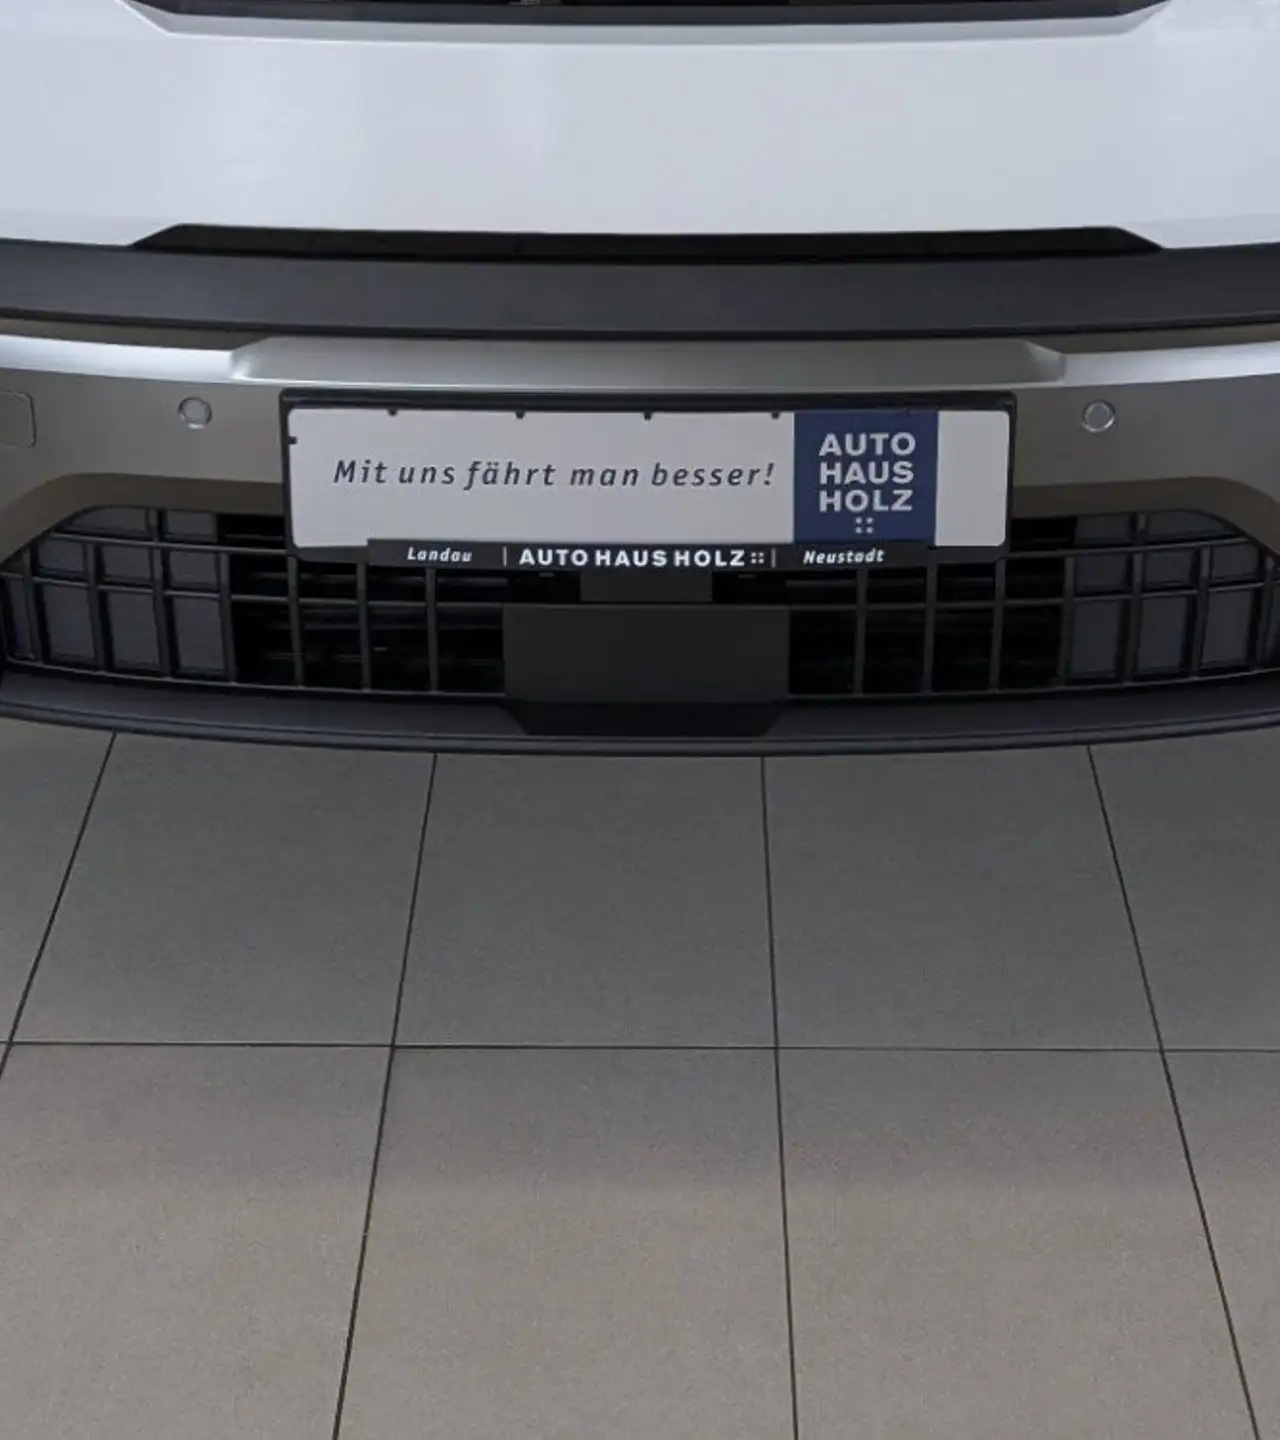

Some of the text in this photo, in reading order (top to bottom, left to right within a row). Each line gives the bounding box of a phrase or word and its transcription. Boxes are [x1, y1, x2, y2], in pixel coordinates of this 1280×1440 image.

[819, 432, 916, 456] AUTO
[333, 460, 775, 490] Mit uns fährt man besser!
[819, 461, 914, 485] HAUS
[819, 489, 913, 512] HOLZ
[407, 546, 885, 567] Landau AUTO HAUS HOLZ Neustadt
